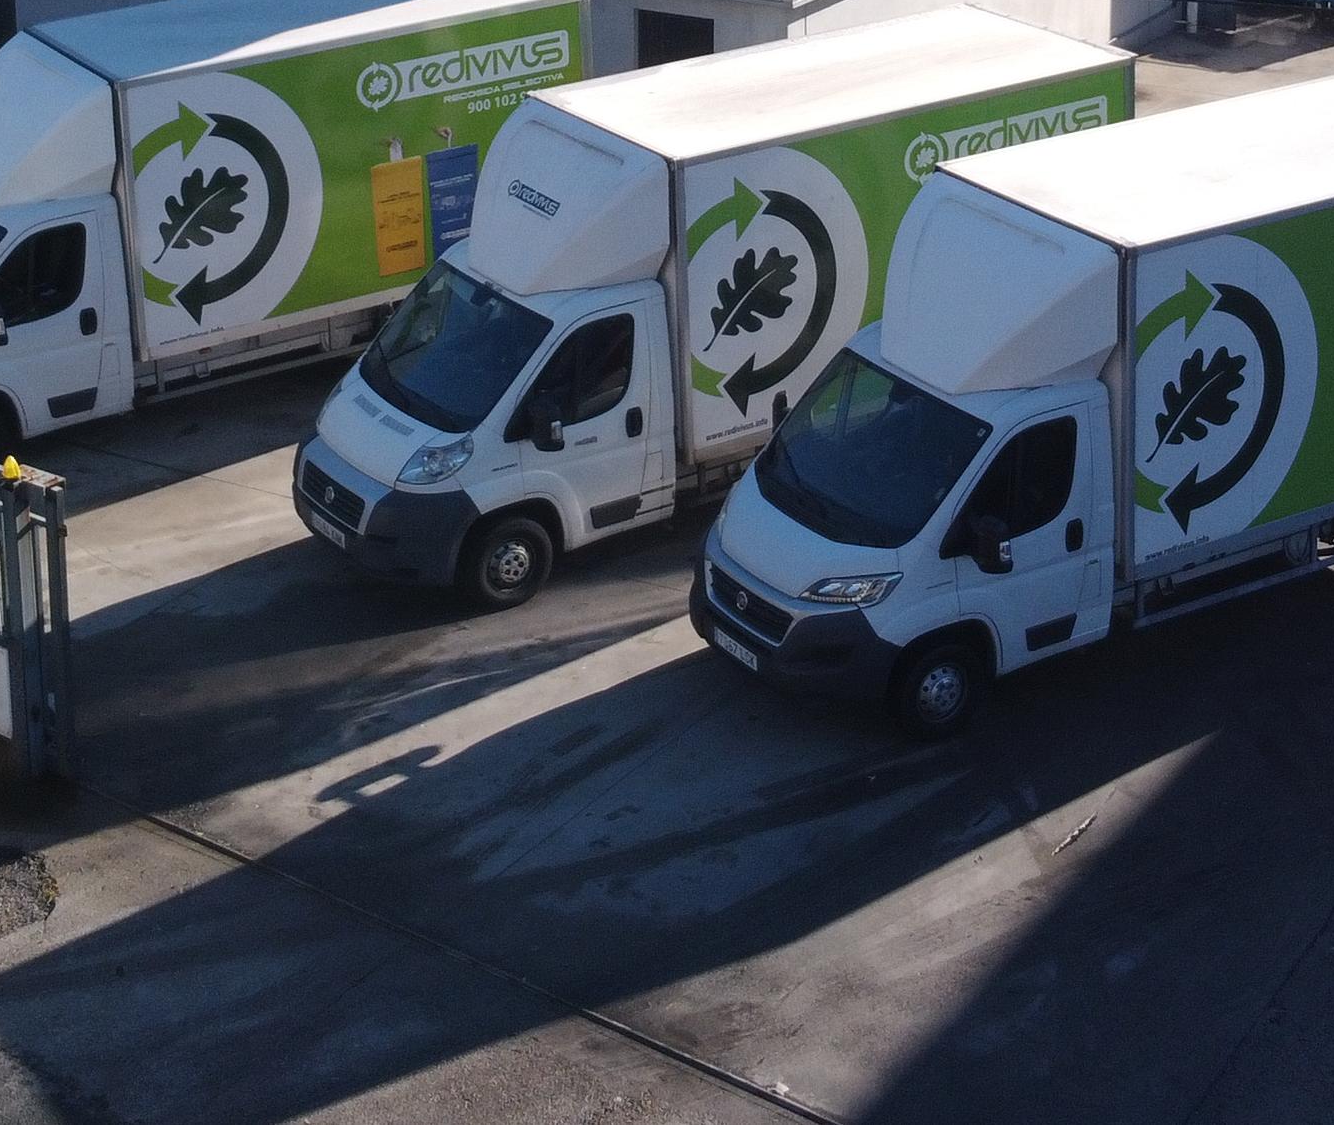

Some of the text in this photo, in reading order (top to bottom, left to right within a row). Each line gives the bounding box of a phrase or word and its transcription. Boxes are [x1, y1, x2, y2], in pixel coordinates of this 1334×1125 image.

[408, 37, 563, 93] redivivus
[467, 98, 491, 114] 900
[495, 94, 517, 108] 102
